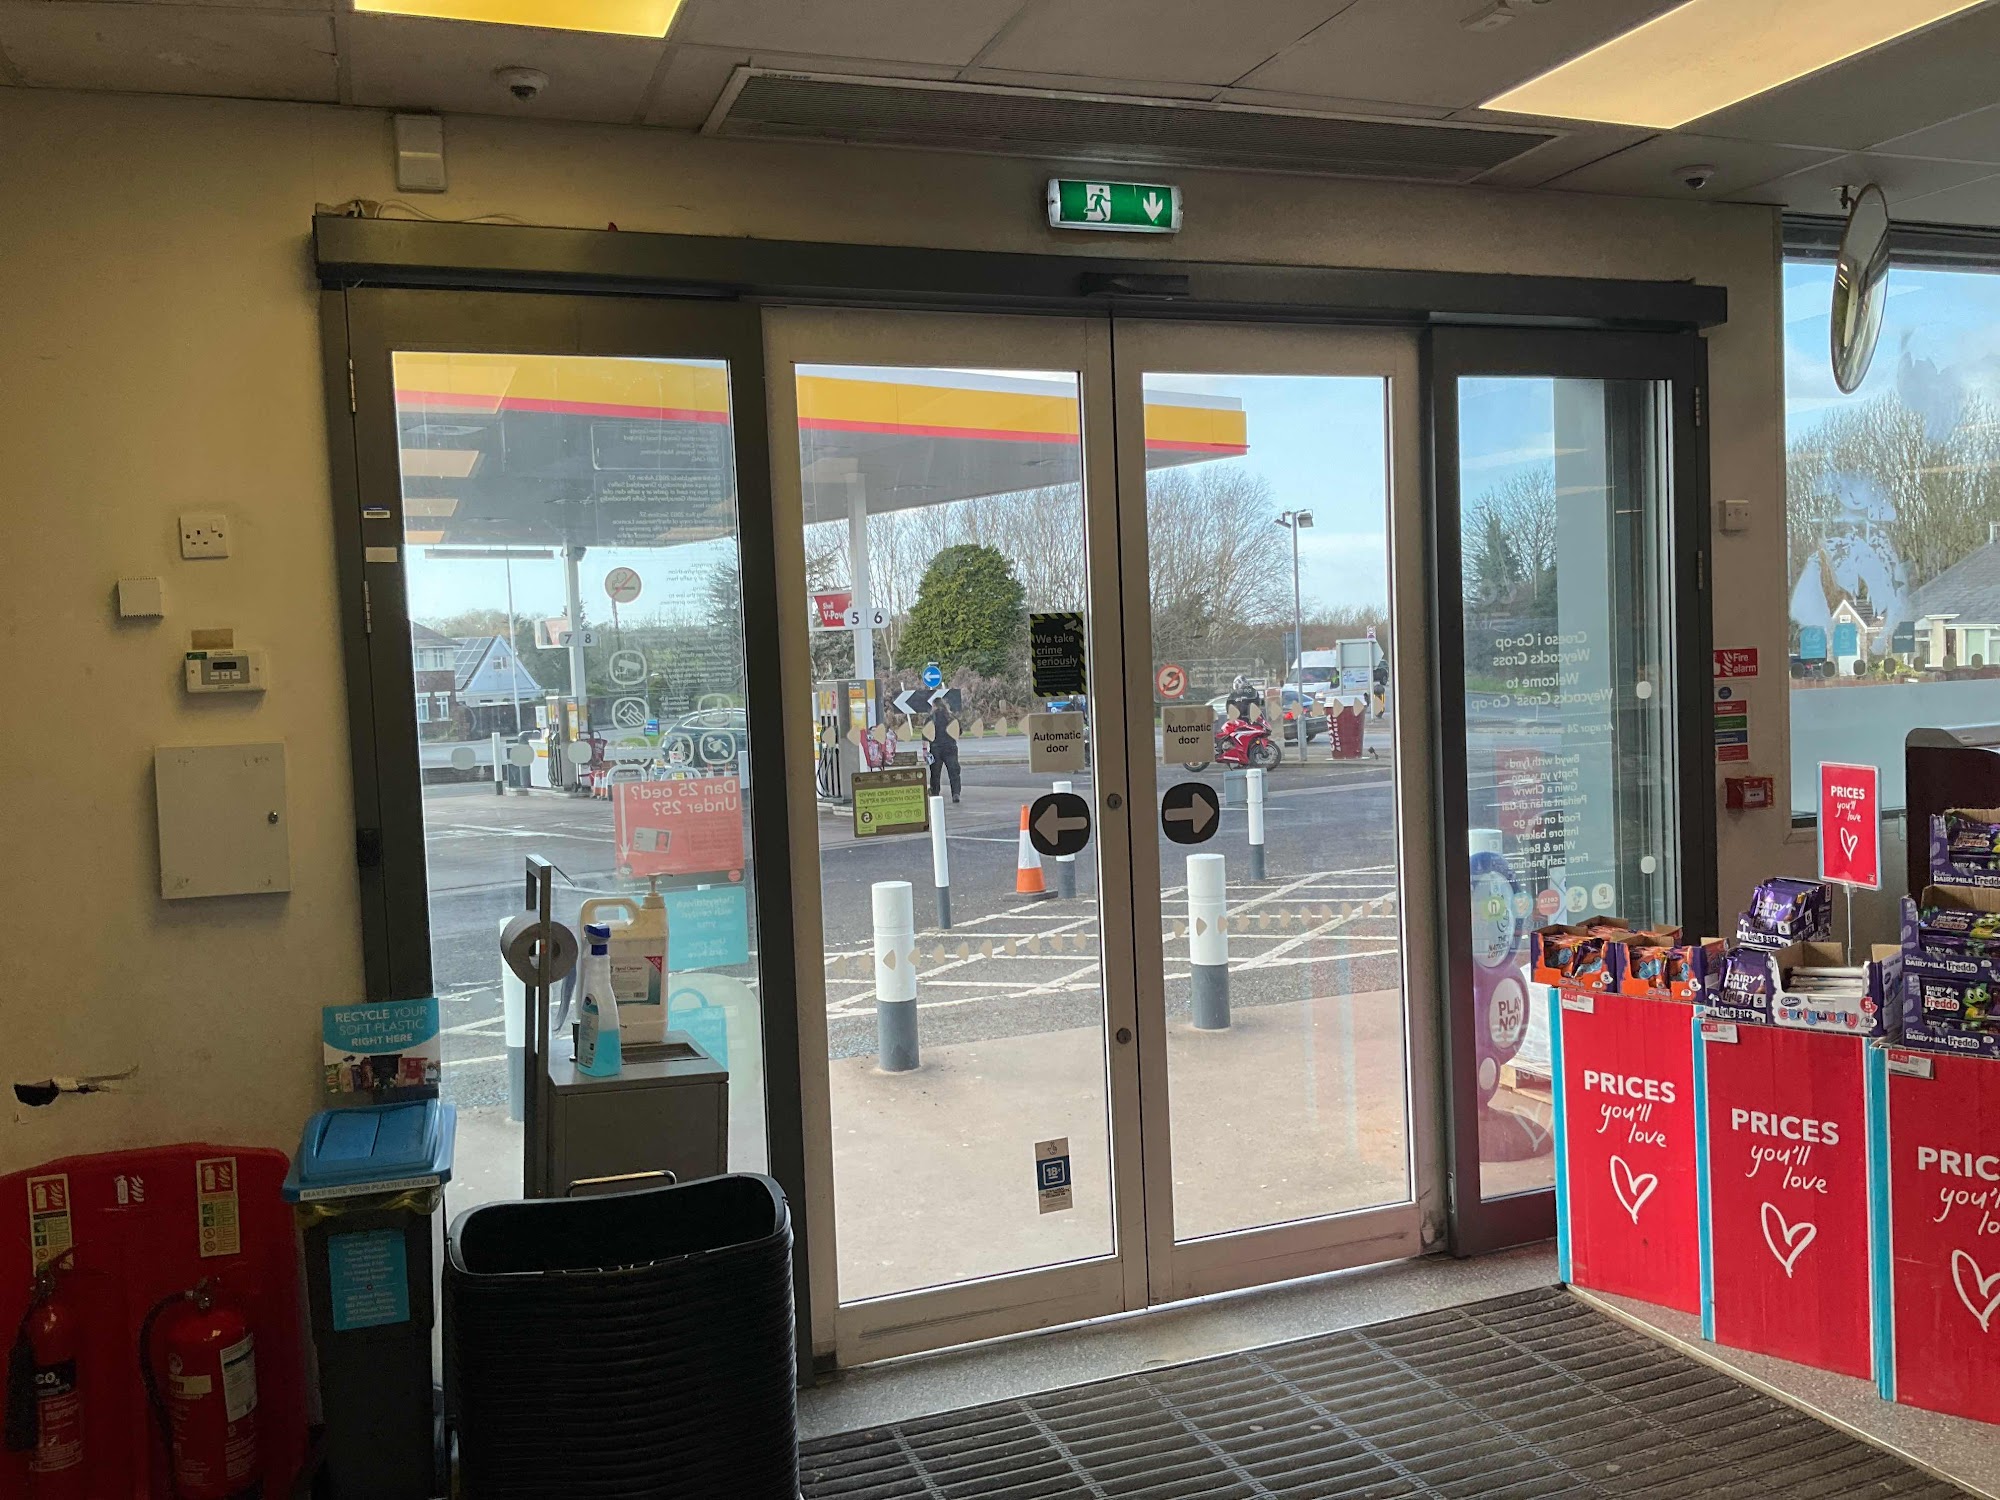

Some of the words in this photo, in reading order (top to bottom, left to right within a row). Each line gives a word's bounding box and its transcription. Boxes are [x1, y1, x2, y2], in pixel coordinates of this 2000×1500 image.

[823, 602, 833, 610] Shell
[823, 610, 844, 620] V-Pow
[852, 612, 860, 624] 5
[874, 611, 883, 624] 6
[564, 634, 572, 644] 7
[585, 634, 592, 643] 8
[1035, 634, 1051, 644] We
[1054, 633, 1074, 643] take
[1036, 645, 1062, 656] crime
[1037, 654, 1078, 667] seriously
[1733, 653, 1749, 662] Fire
[1733, 664, 1757, 673] alarm
[1166, 723, 1211, 733] Automatic
[1033, 731, 1081, 742] Automatic
[1178, 736, 1199, 745] door
[1046, 744, 1069, 753] door
[1831, 786, 1865, 800] PRICES
[1835, 800, 1856, 818] you'll
[1847, 811, 1861, 822] love
[1976, 876, 2000, 886] Fredd
[1759, 901, 1785, 911] DAIRY
[1759, 909, 1777, 919] MILK
[1905, 959, 1927, 968] DAIRY
[1928, 961, 1945, 969] MILK
[1948, 961, 1976, 972] Freddo
[1726, 973, 1757, 984] DAIRY
[1725, 981, 1749, 991] MILK
[1926, 985, 1946, 993] DAIRY
[1925, 996, 1958, 1009] Freddo
[335, 1009, 390, 1023] RECYCLE
[394, 1006, 427, 1017] YOUR
[340, 1023, 371, 1036] SOFT
[375, 1019, 425, 1033] PLASTIC
[352, 1035, 383, 1047] RIGHT
[386, 1033, 413, 1043] HERE
[1906, 1034, 1928, 1042] DAIRY
[1929, 1036, 1947, 1044] MILK
[1949, 1036, 1978, 1047] Freddo
[1584, 1070, 1676, 1104] PRICES
[1596, 1103, 1652, 1134] you'll
[1731, 1107, 1840, 1146] PRICES
[1628, 1122, 1667, 1147] love
[1745, 1145, 1811, 1178] you'll
[1918, 1146, 2000, 1181] PRIC
[1782, 1167, 1828, 1194] love
[1933, 1187, 2000, 1222] you'l
[1978, 1210, 2000, 1236] lo
